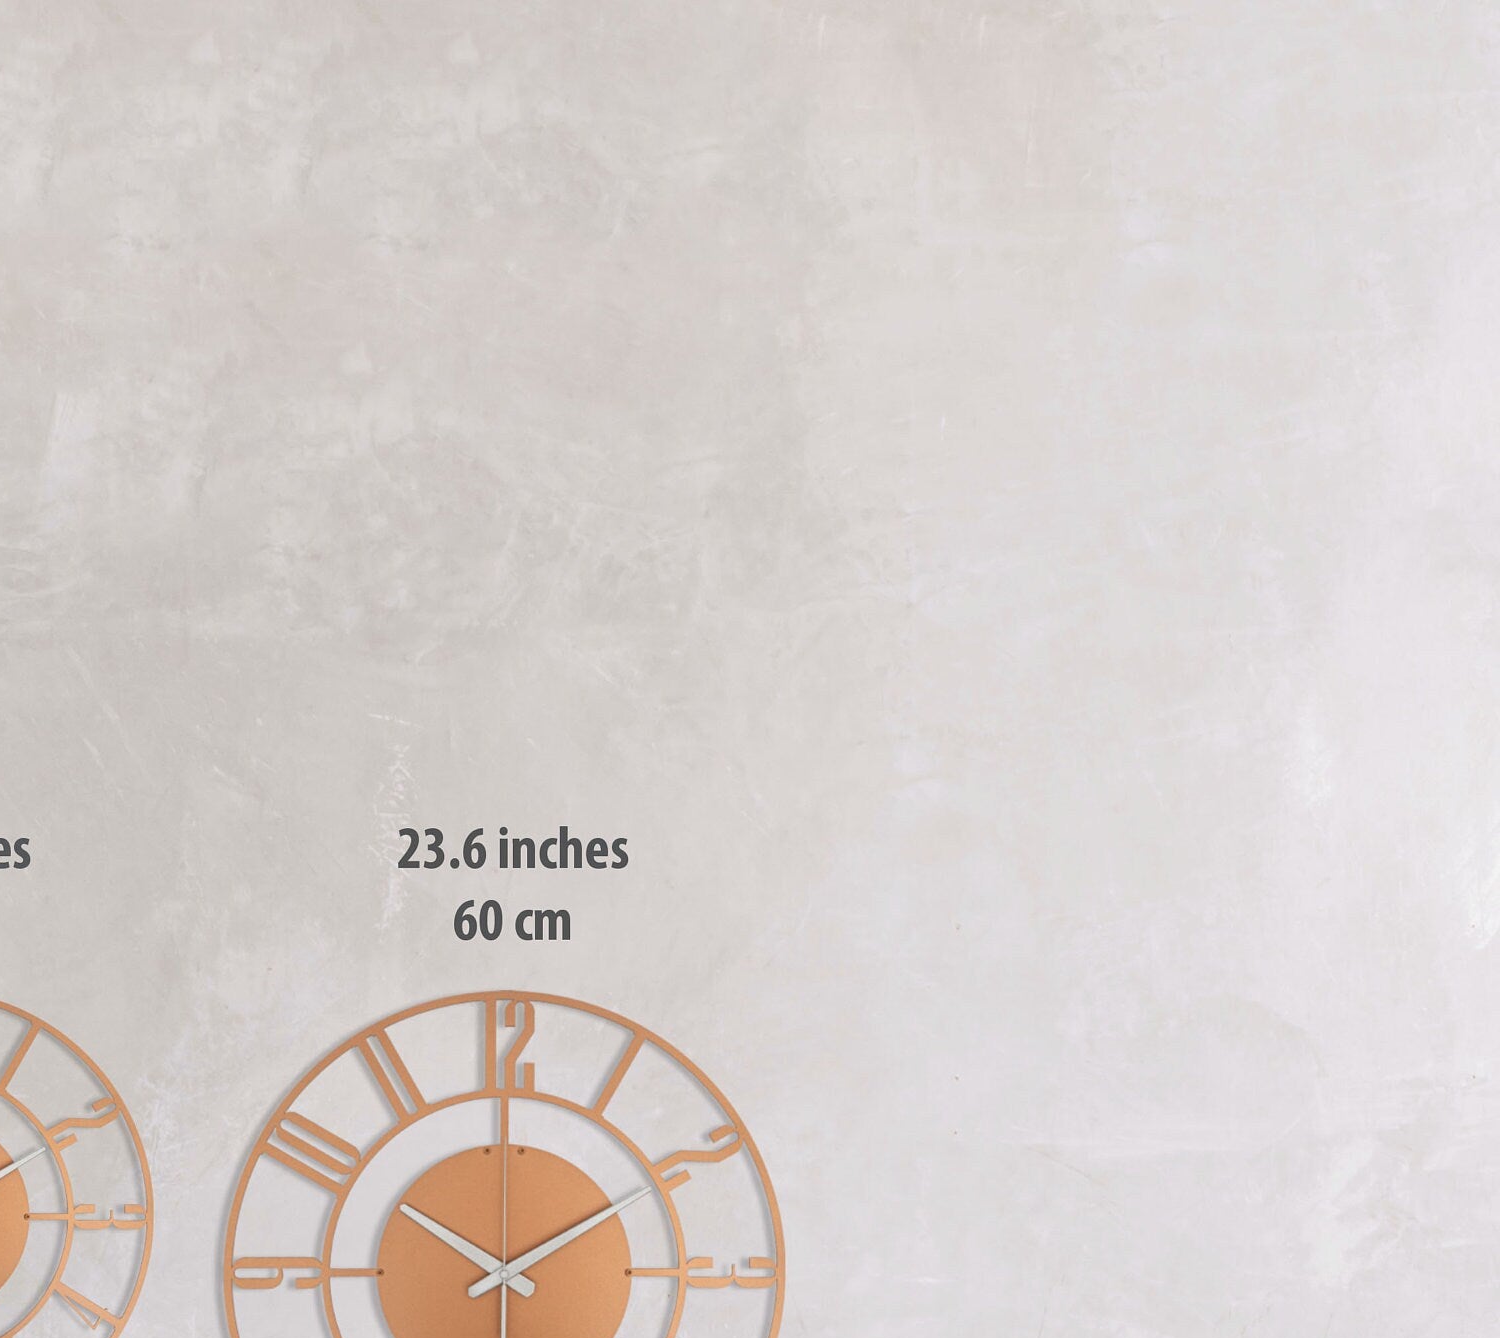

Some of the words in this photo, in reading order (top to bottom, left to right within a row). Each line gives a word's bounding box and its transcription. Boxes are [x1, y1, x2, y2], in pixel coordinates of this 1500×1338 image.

[484, 1000, 536, 1091] 12
[46, 1096, 120, 1153] 2
[263, 1111, 361, 1196] 10
[652, 1123, 743, 1193] 2
[72, 1203, 147, 1230] 3
[233, 1256, 325, 1290] 9
[685, 1256, 777, 1289] 3
[52, 1280, 124, 1330] 4
